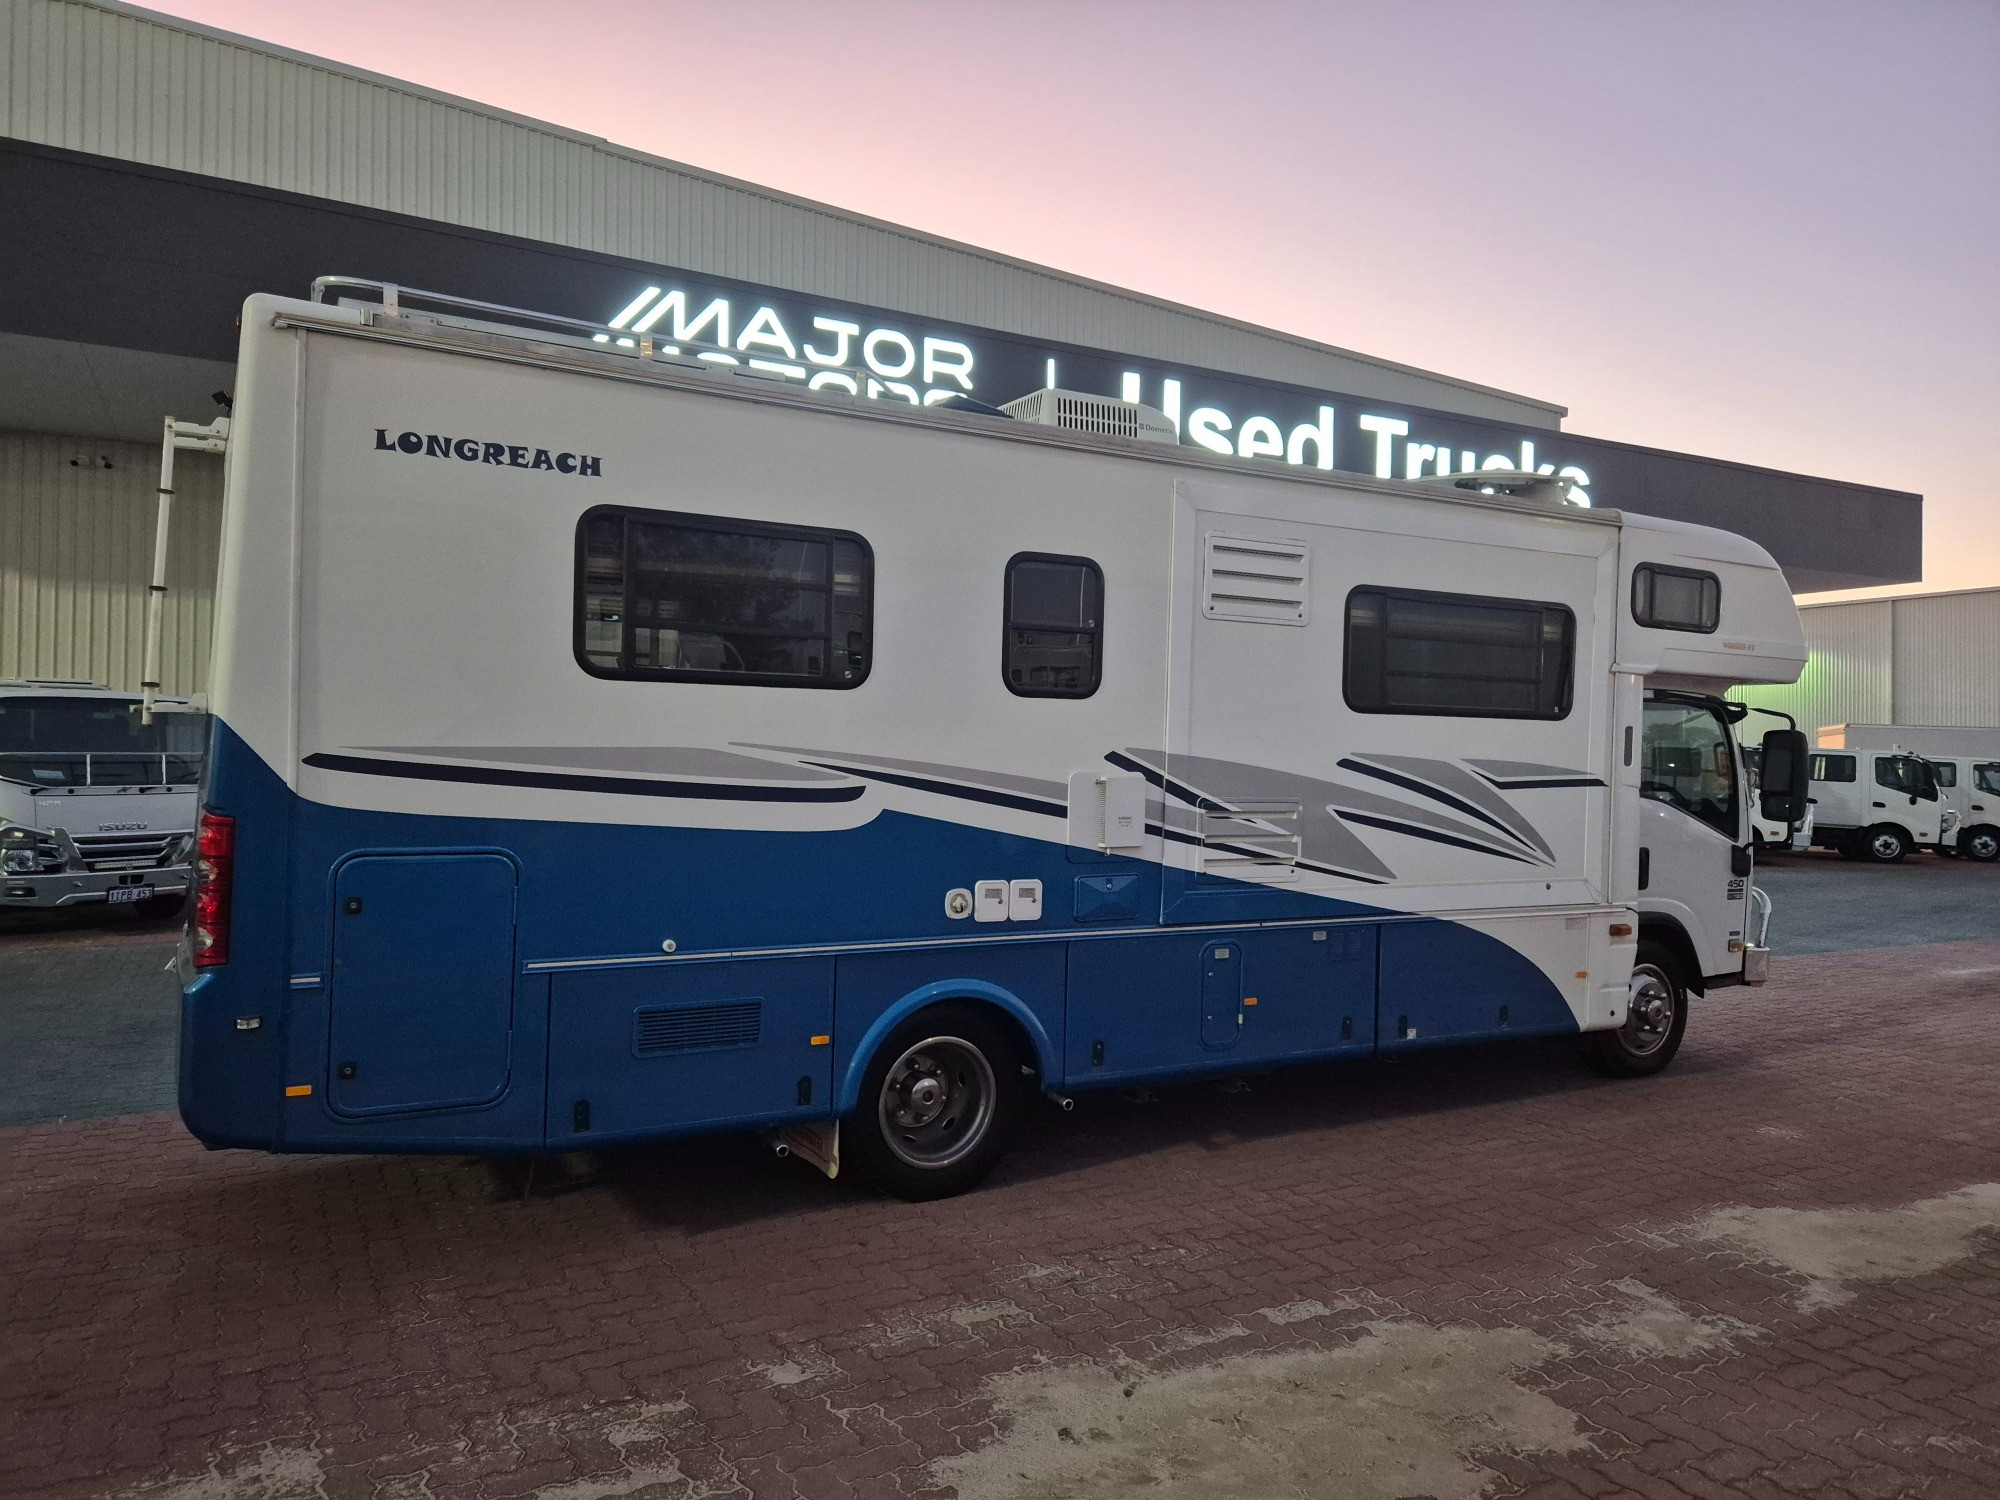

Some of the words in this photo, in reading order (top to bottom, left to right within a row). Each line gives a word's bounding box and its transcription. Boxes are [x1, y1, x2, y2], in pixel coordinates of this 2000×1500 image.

[608, 286, 974, 389] MAJOR
[1145, 423, 1173, 435] Dometic
[374, 428, 603, 478] LONGREACH
[98, 821, 148, 832] ISUZU
[1727, 879, 1744, 888] 450
